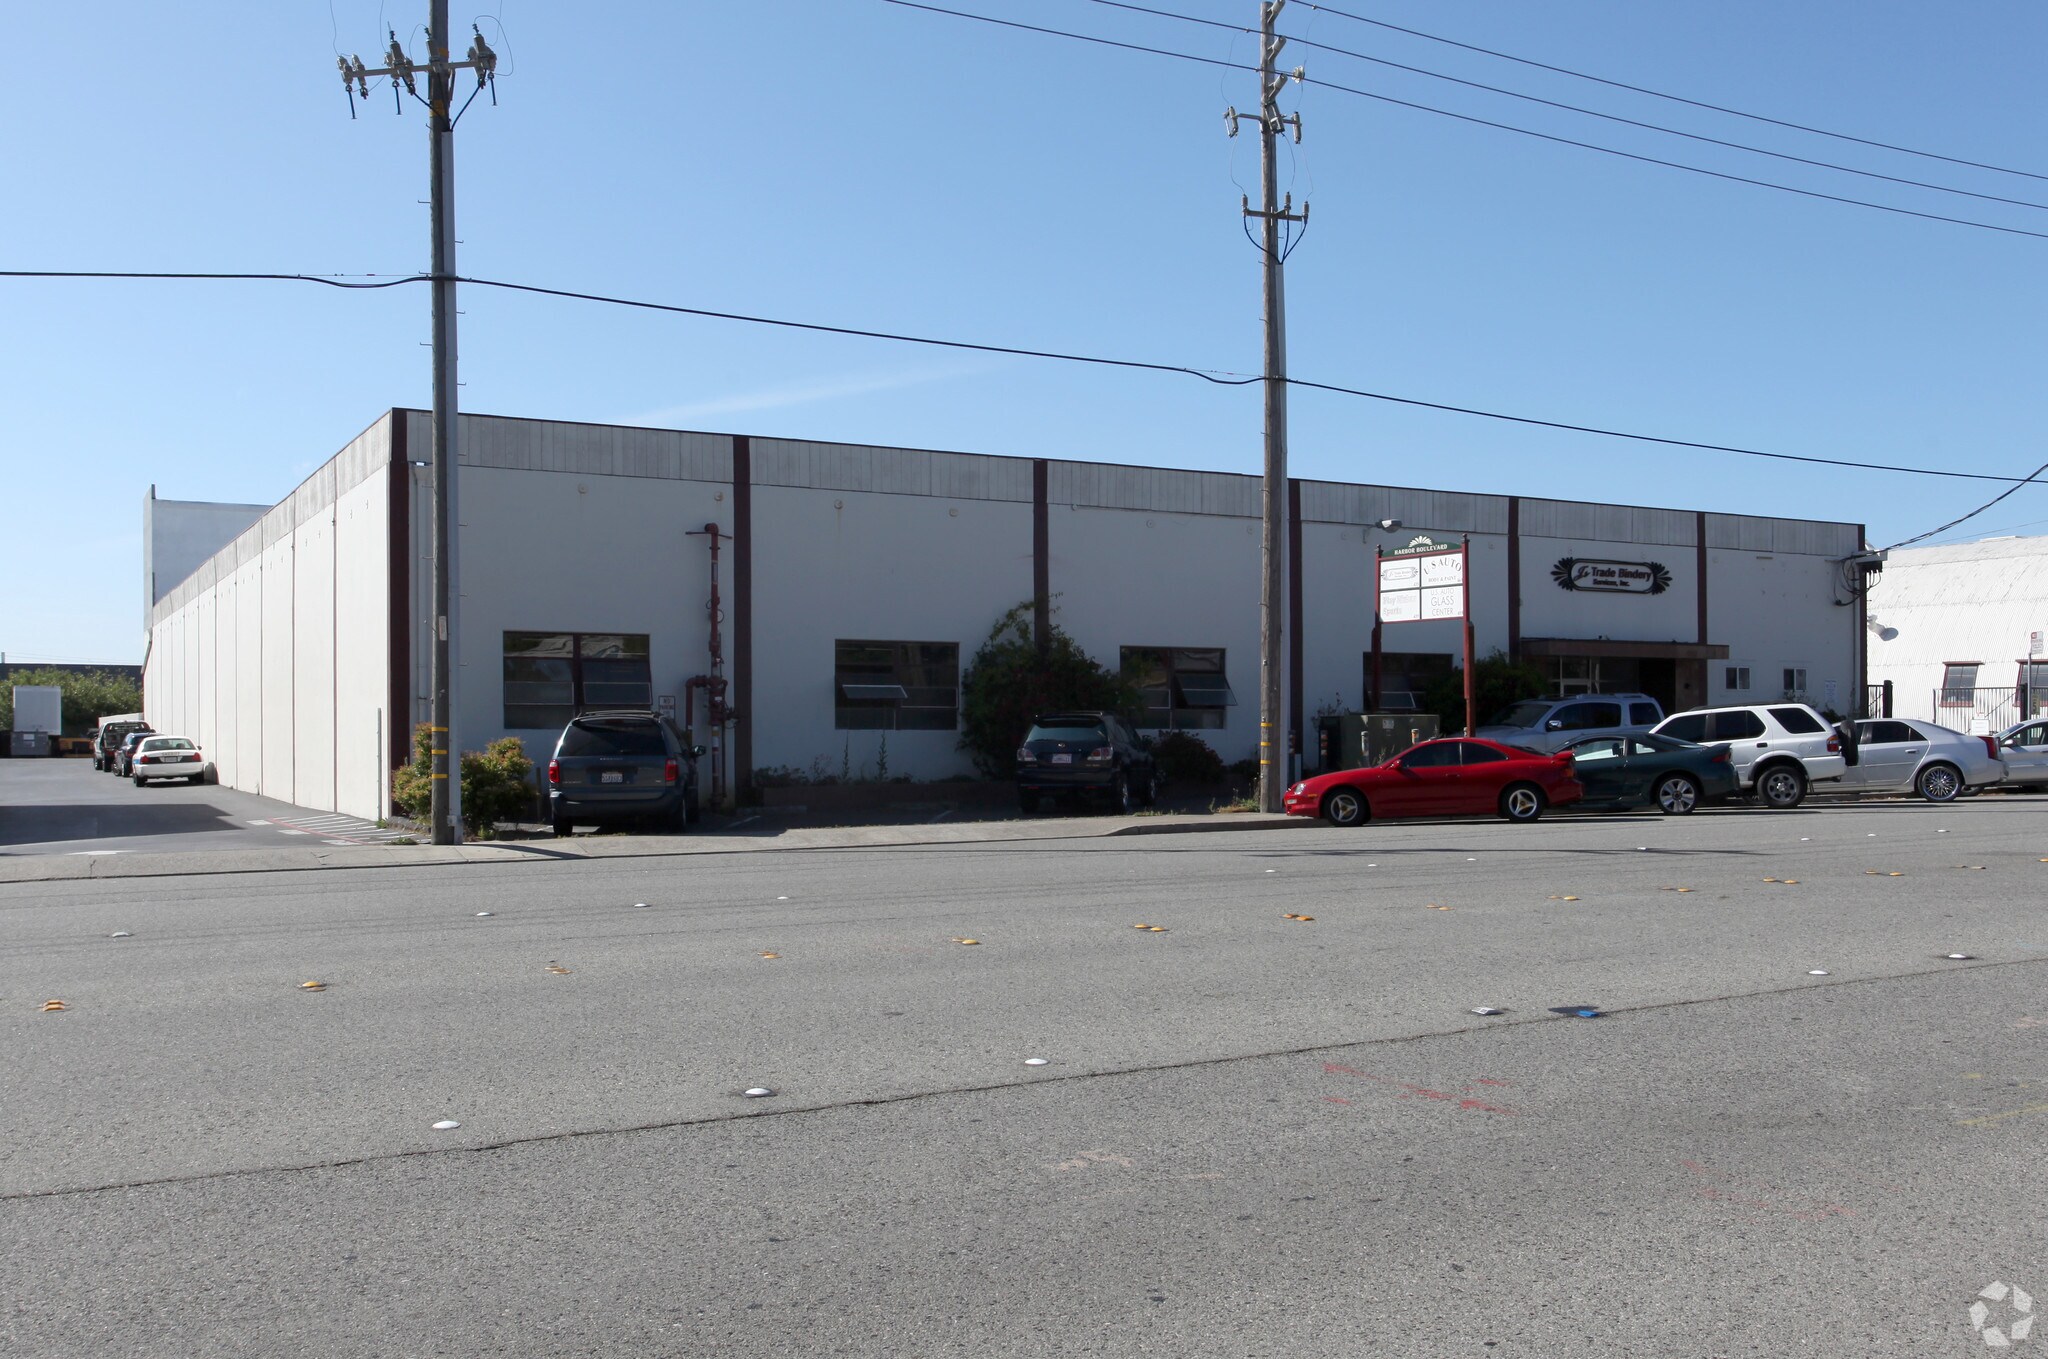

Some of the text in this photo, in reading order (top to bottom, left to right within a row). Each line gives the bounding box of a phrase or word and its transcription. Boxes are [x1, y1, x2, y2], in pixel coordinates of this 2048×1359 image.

[1394, 544, 1448, 555] HARBOR BOULEVARD
[1438, 557, 1462, 572] AUTO
[1591, 566, 1616, 578] Trade
[1618, 568, 1652, 582] Bindery
[1430, 595, 1455, 607] GLASS
[1431, 607, 1454, 616] CENTER
